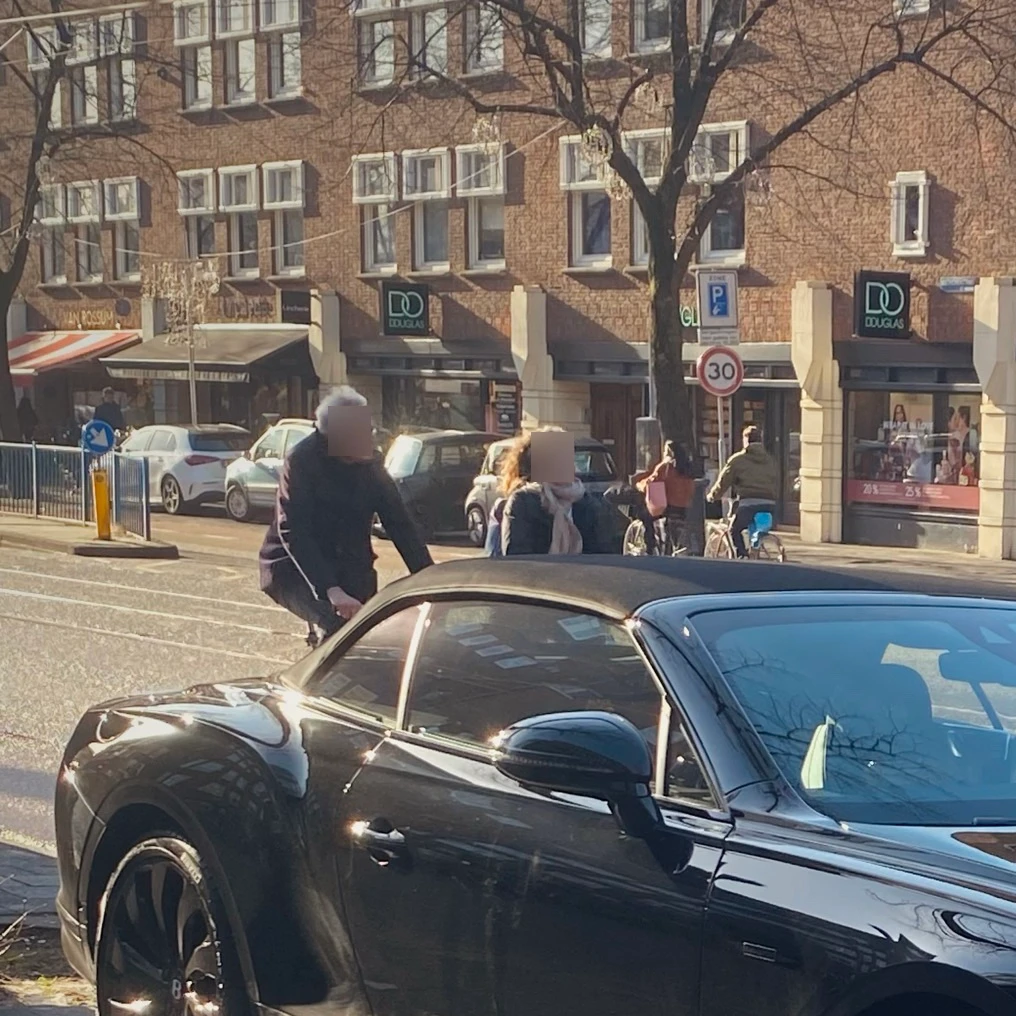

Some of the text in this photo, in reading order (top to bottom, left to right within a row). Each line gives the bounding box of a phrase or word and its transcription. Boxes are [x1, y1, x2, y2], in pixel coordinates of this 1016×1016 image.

[712, 286, 724, 303] P
[389, 318, 424, 328] DOUGLAS
[865, 317, 904, 329] DOUGLAS
[708, 362, 735, 380] 30
